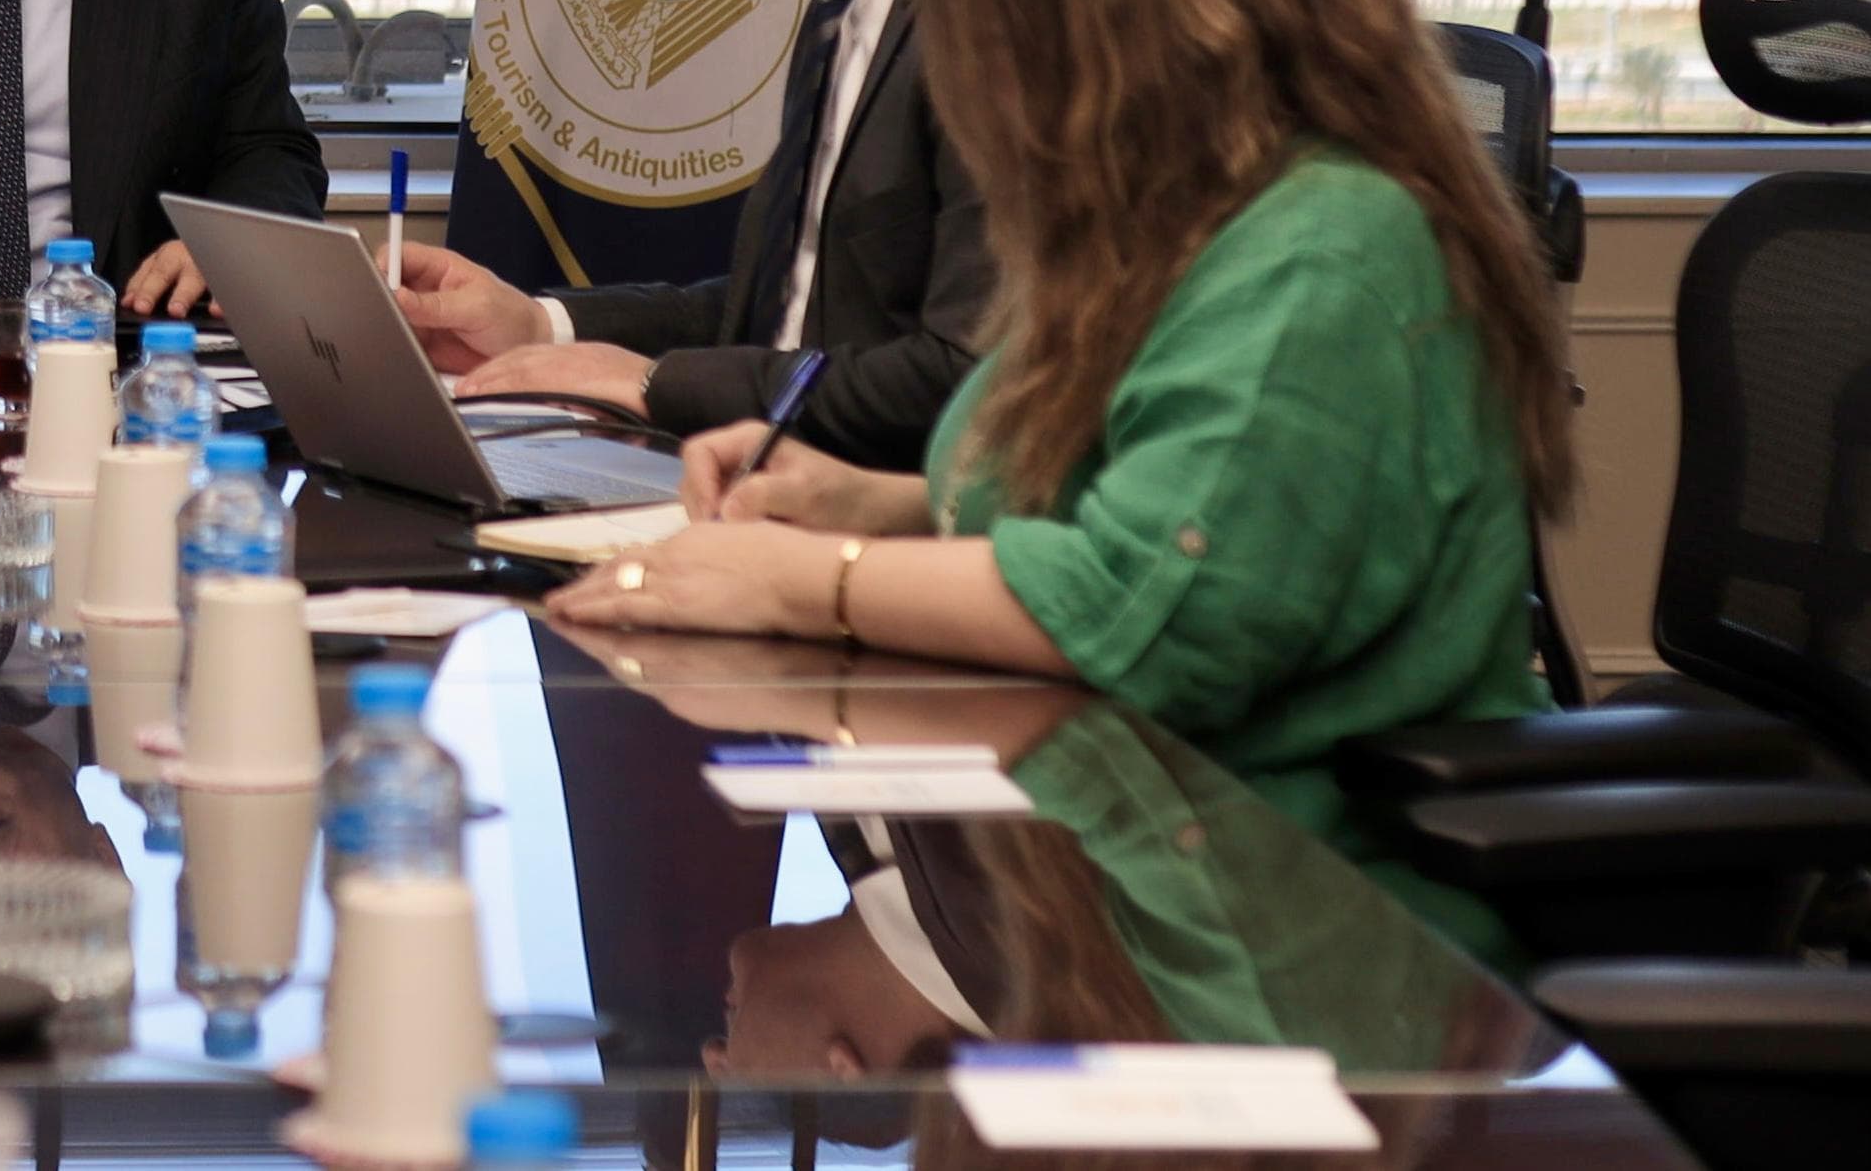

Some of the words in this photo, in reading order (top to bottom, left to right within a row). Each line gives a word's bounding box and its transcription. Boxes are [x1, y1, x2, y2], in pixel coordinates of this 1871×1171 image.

[484, 10, 552, 131] Tourism
[553, 120, 575, 151] &
[577, 136, 744, 187] Antiquities
